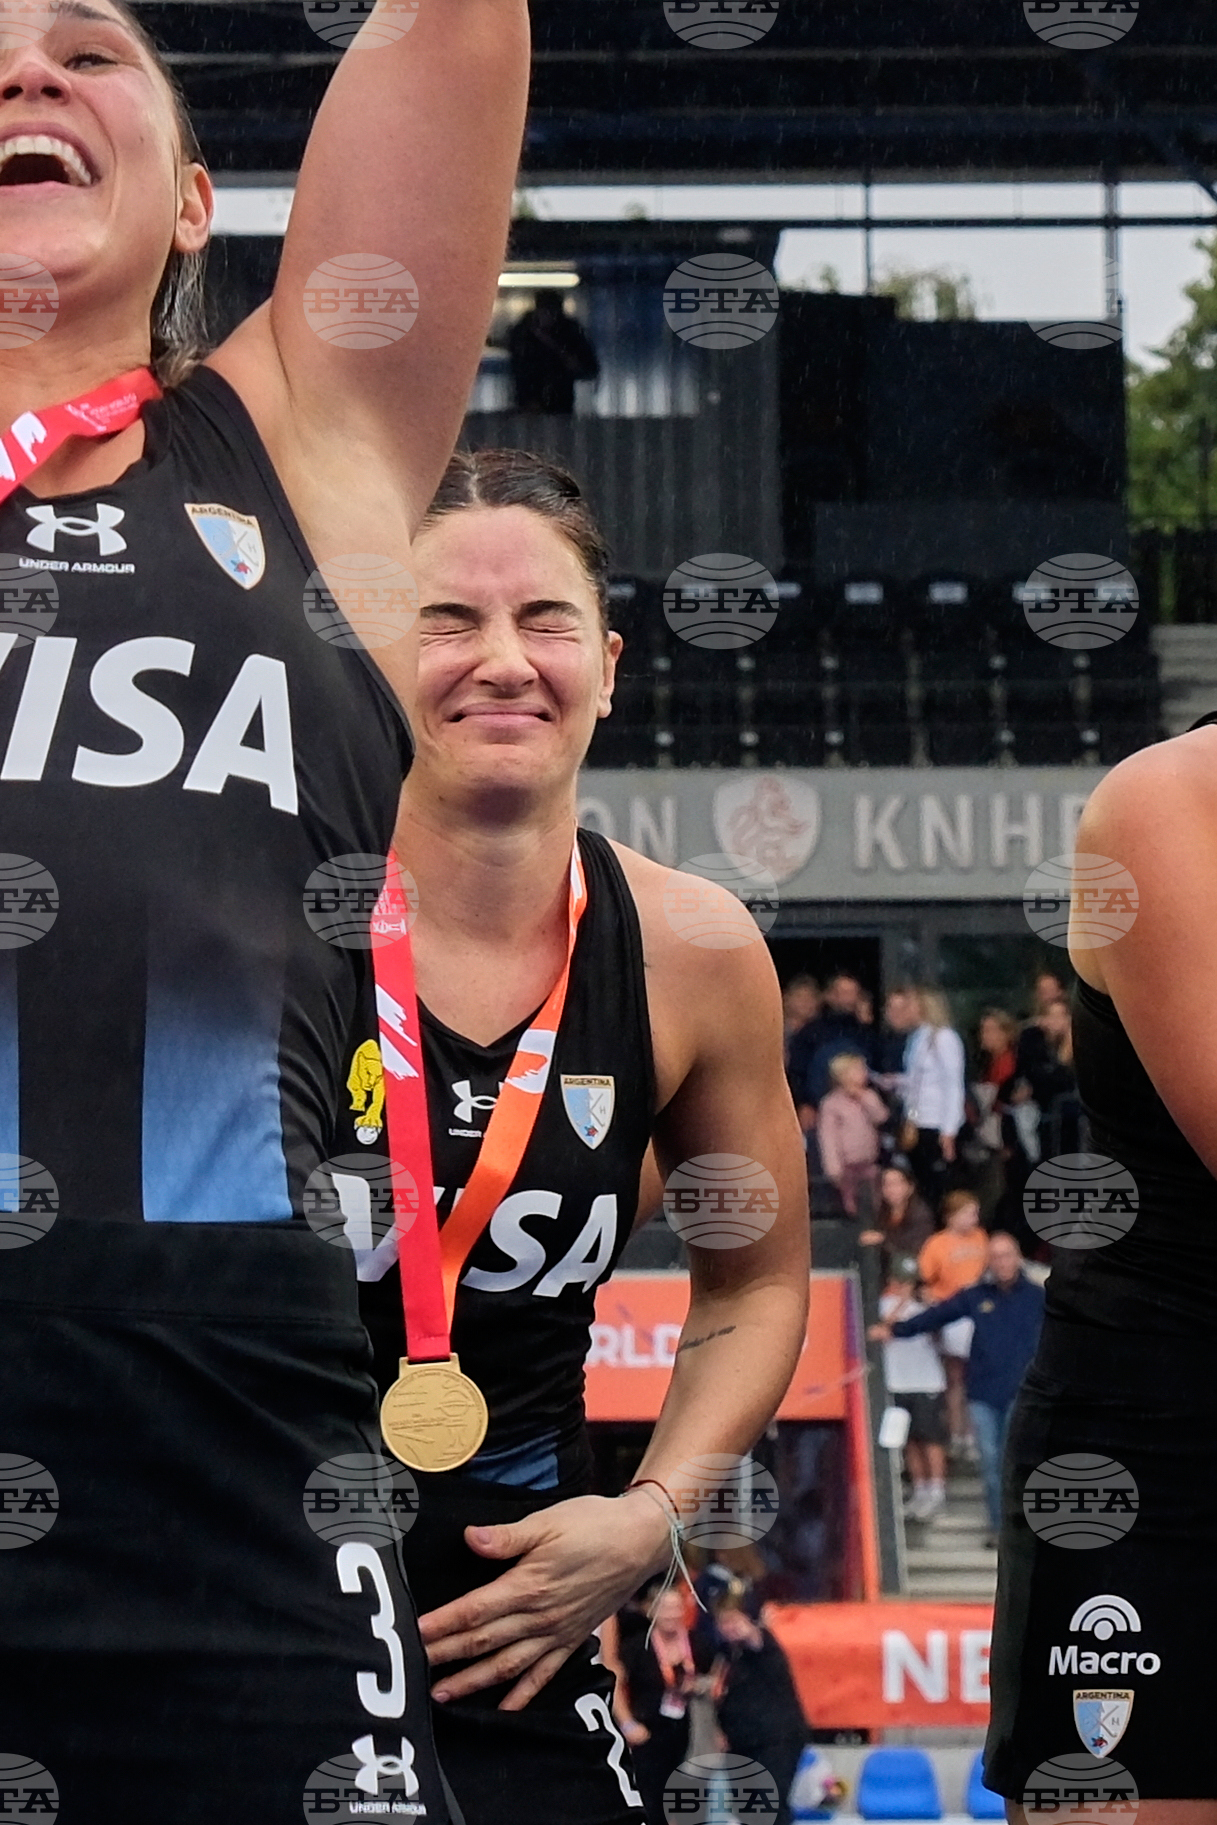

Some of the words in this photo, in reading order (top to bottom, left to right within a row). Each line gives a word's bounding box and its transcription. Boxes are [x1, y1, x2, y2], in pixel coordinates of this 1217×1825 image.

[18, 557, 70, 572] UNDER
[71, 561, 136, 575] ARMOUR
[331, 1172, 618, 1298] VSA
[335, 1541, 406, 1719] 3
[1048, 1645, 1161, 1675] Macro
[1075, 1692, 1131, 1700] ARGENTINA
